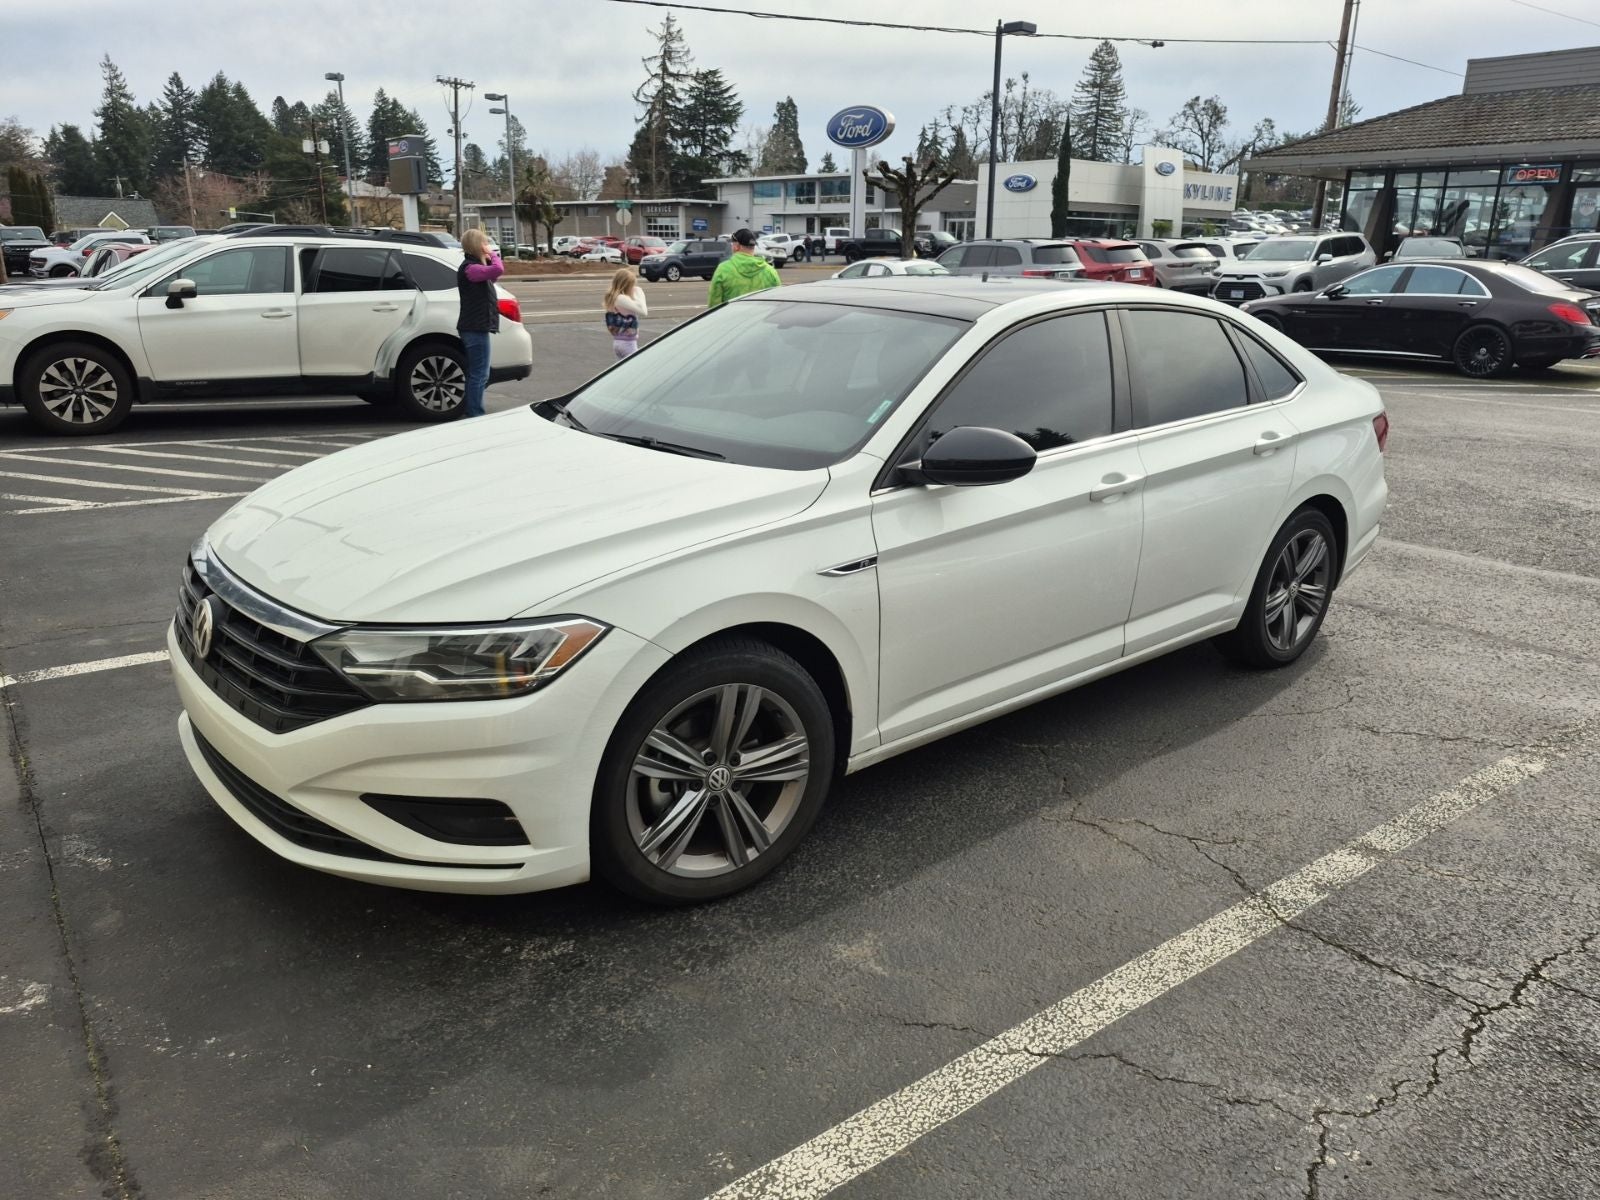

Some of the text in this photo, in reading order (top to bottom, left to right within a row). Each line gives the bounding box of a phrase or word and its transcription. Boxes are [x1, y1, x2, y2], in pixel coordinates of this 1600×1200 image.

[837, 114, 873, 140] Ford
[1516, 168, 1557, 181] OPEN
[1009, 177, 1028, 188] Ford
